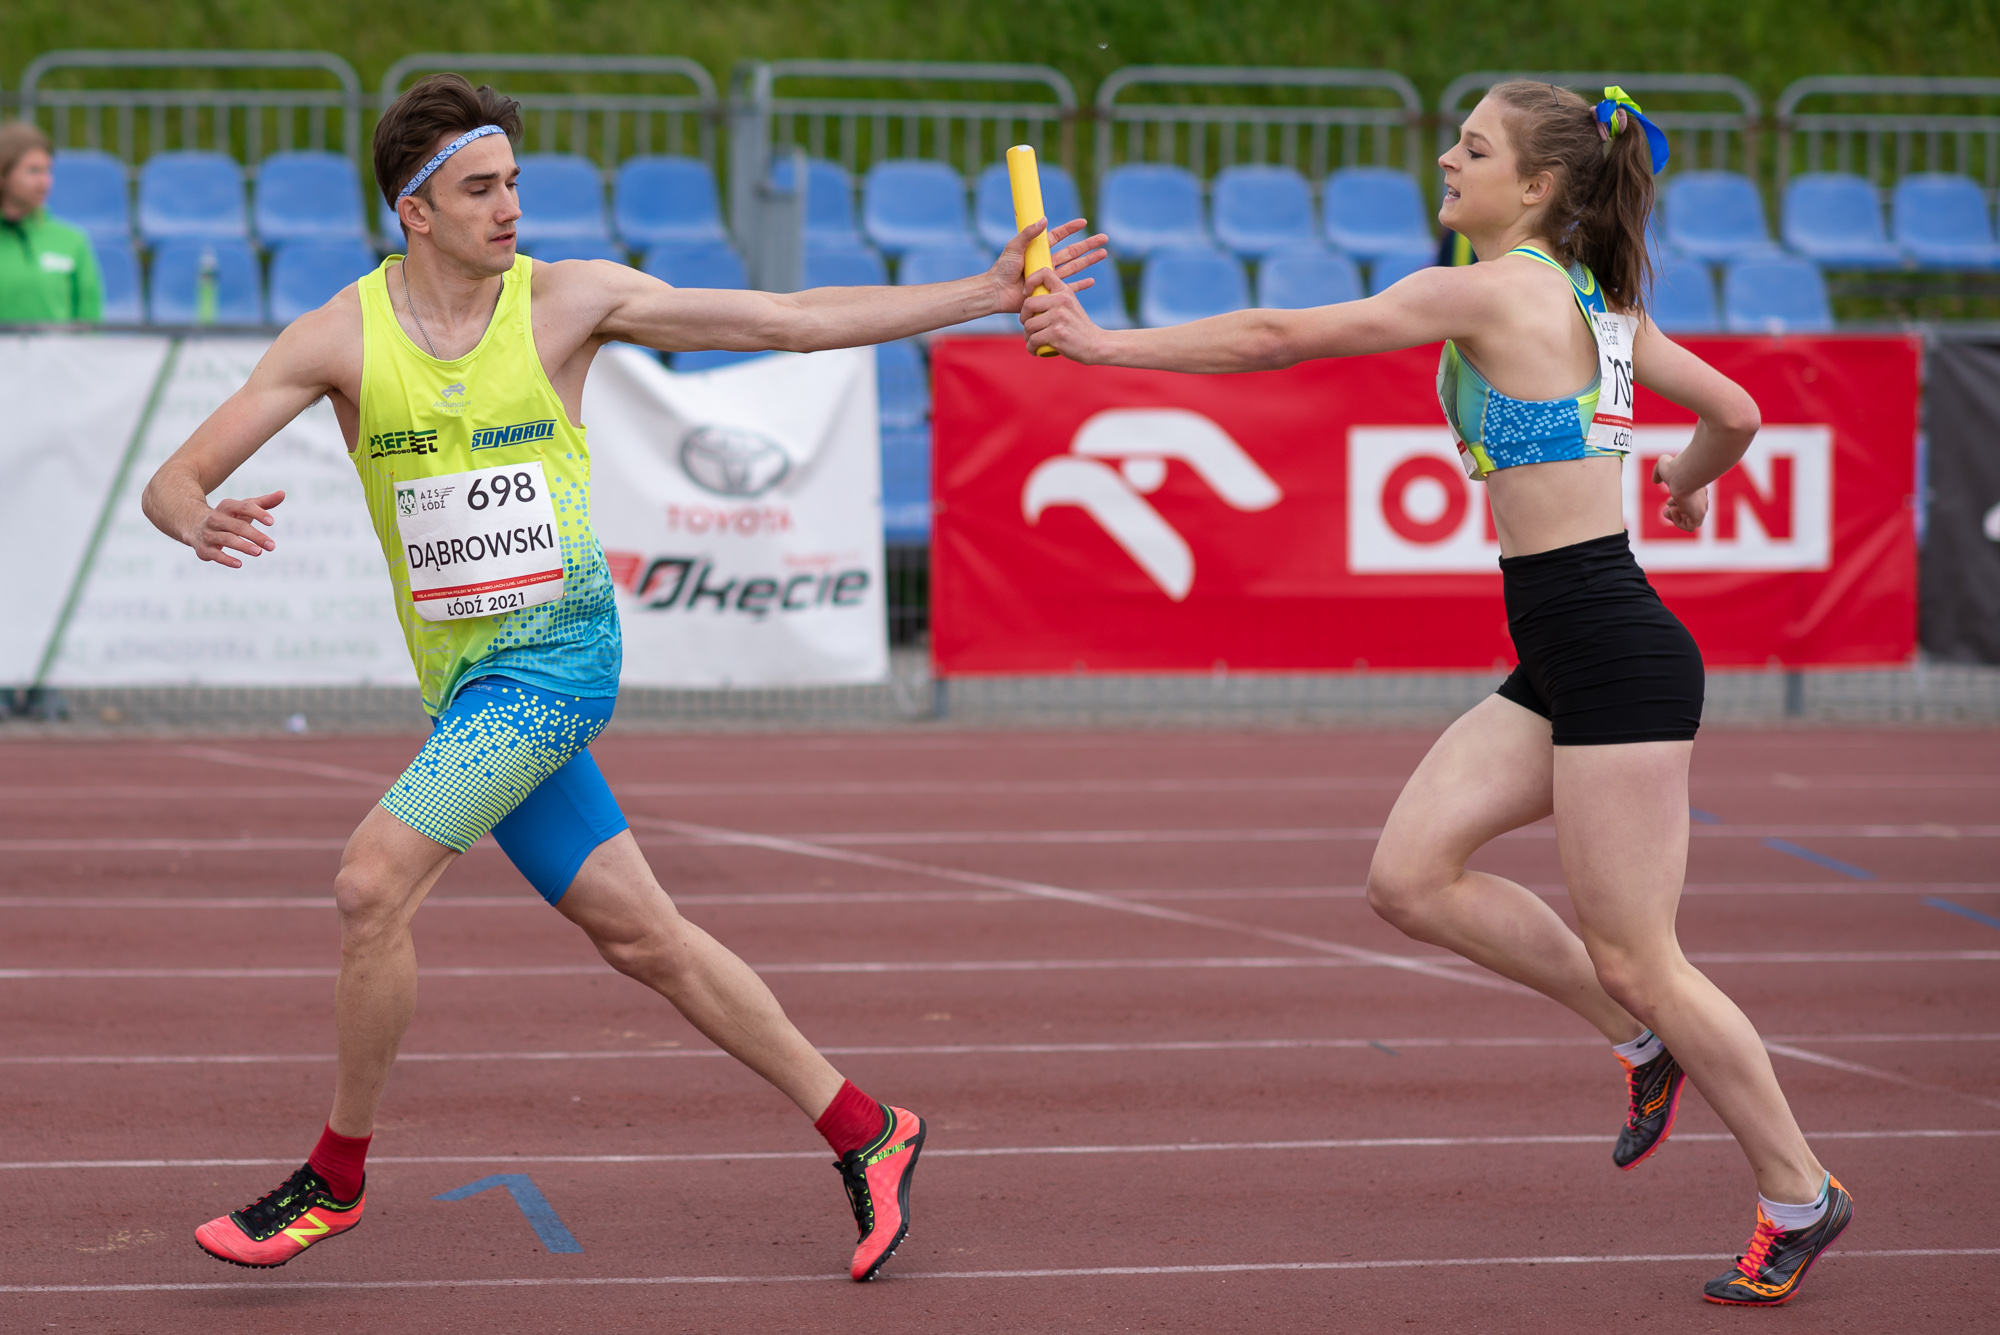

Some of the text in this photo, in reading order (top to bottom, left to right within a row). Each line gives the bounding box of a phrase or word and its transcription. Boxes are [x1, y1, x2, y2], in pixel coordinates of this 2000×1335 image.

[471, 422, 555, 448] SONAROL
[421, 488, 440, 499] AZS
[467, 472, 536, 511] 698
[1380, 454, 1794, 542] OEN
[666, 505, 794, 536] TOYOTA
[408, 523, 554, 572] DĄBROWSKI
[447, 592, 525, 616] ŁÓDŹ 2021
